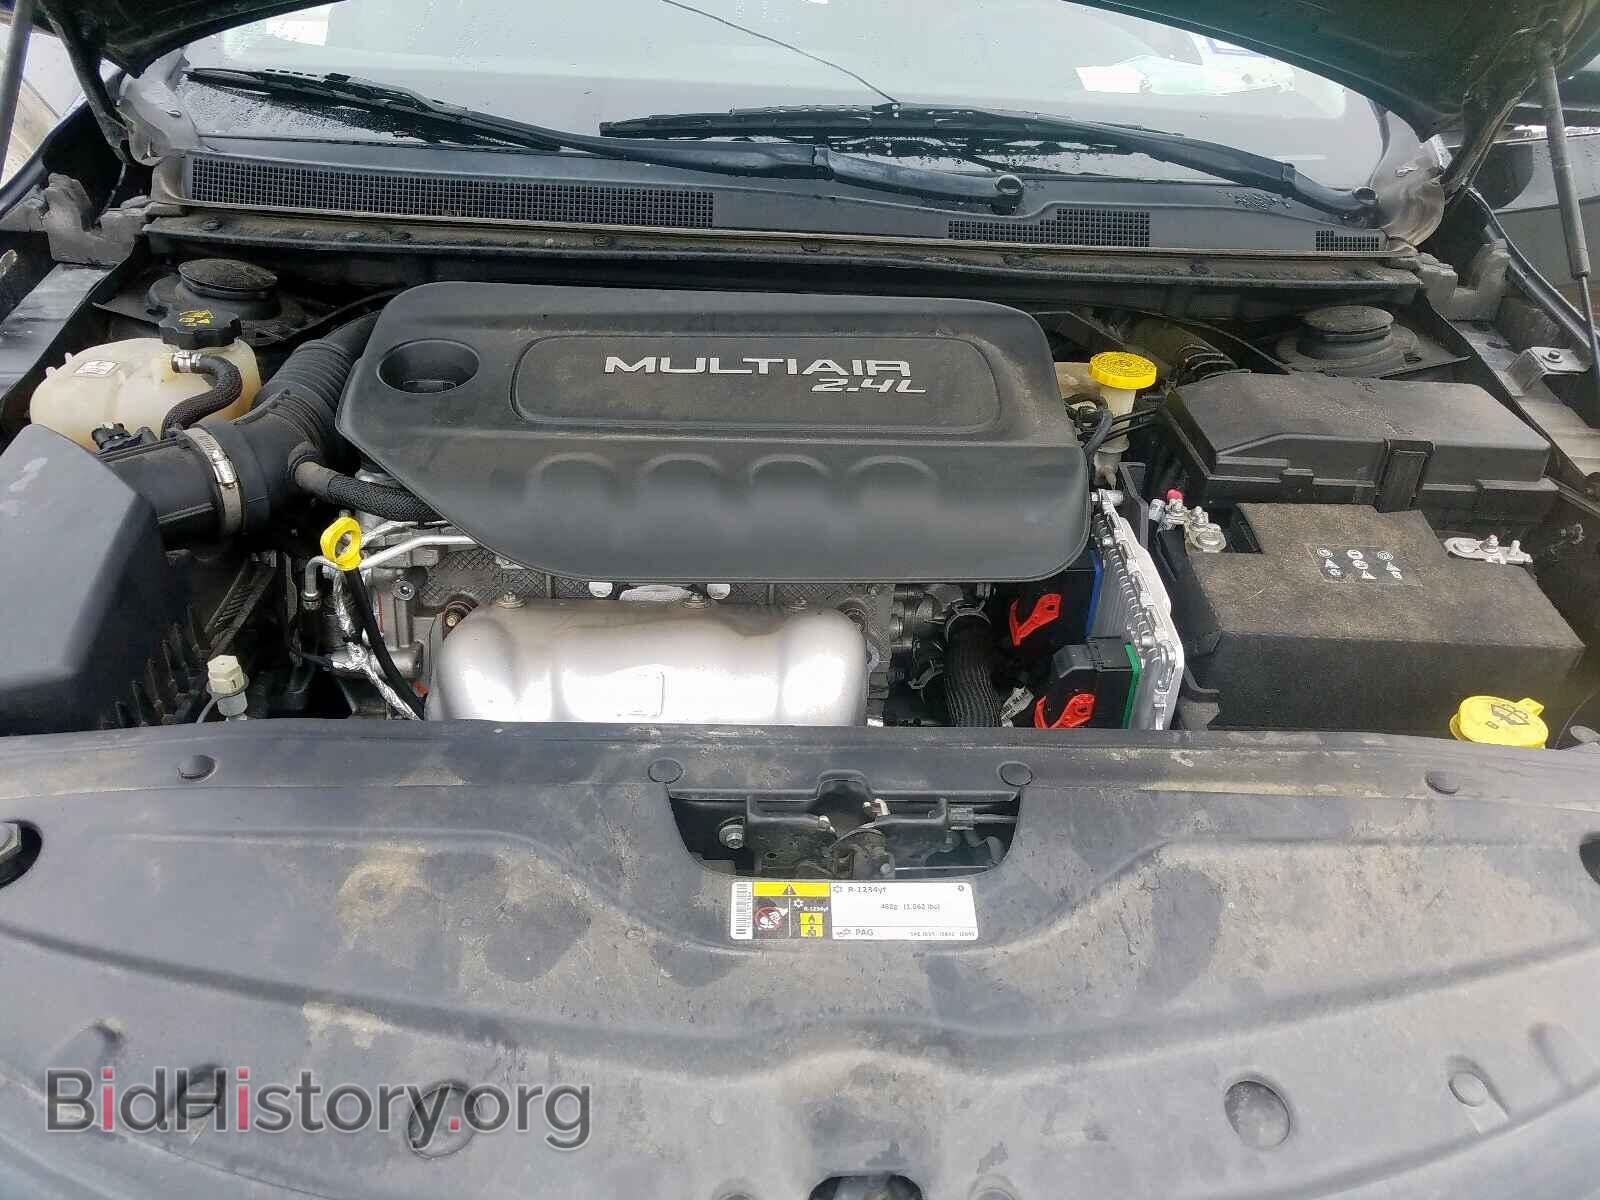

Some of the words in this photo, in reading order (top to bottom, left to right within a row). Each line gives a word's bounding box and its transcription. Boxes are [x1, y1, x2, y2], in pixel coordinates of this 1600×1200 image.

[603, 355, 912, 377] MULTIAIR
[811, 377, 928, 394] 2.4L
[855, 927, 875, 937] PAG
